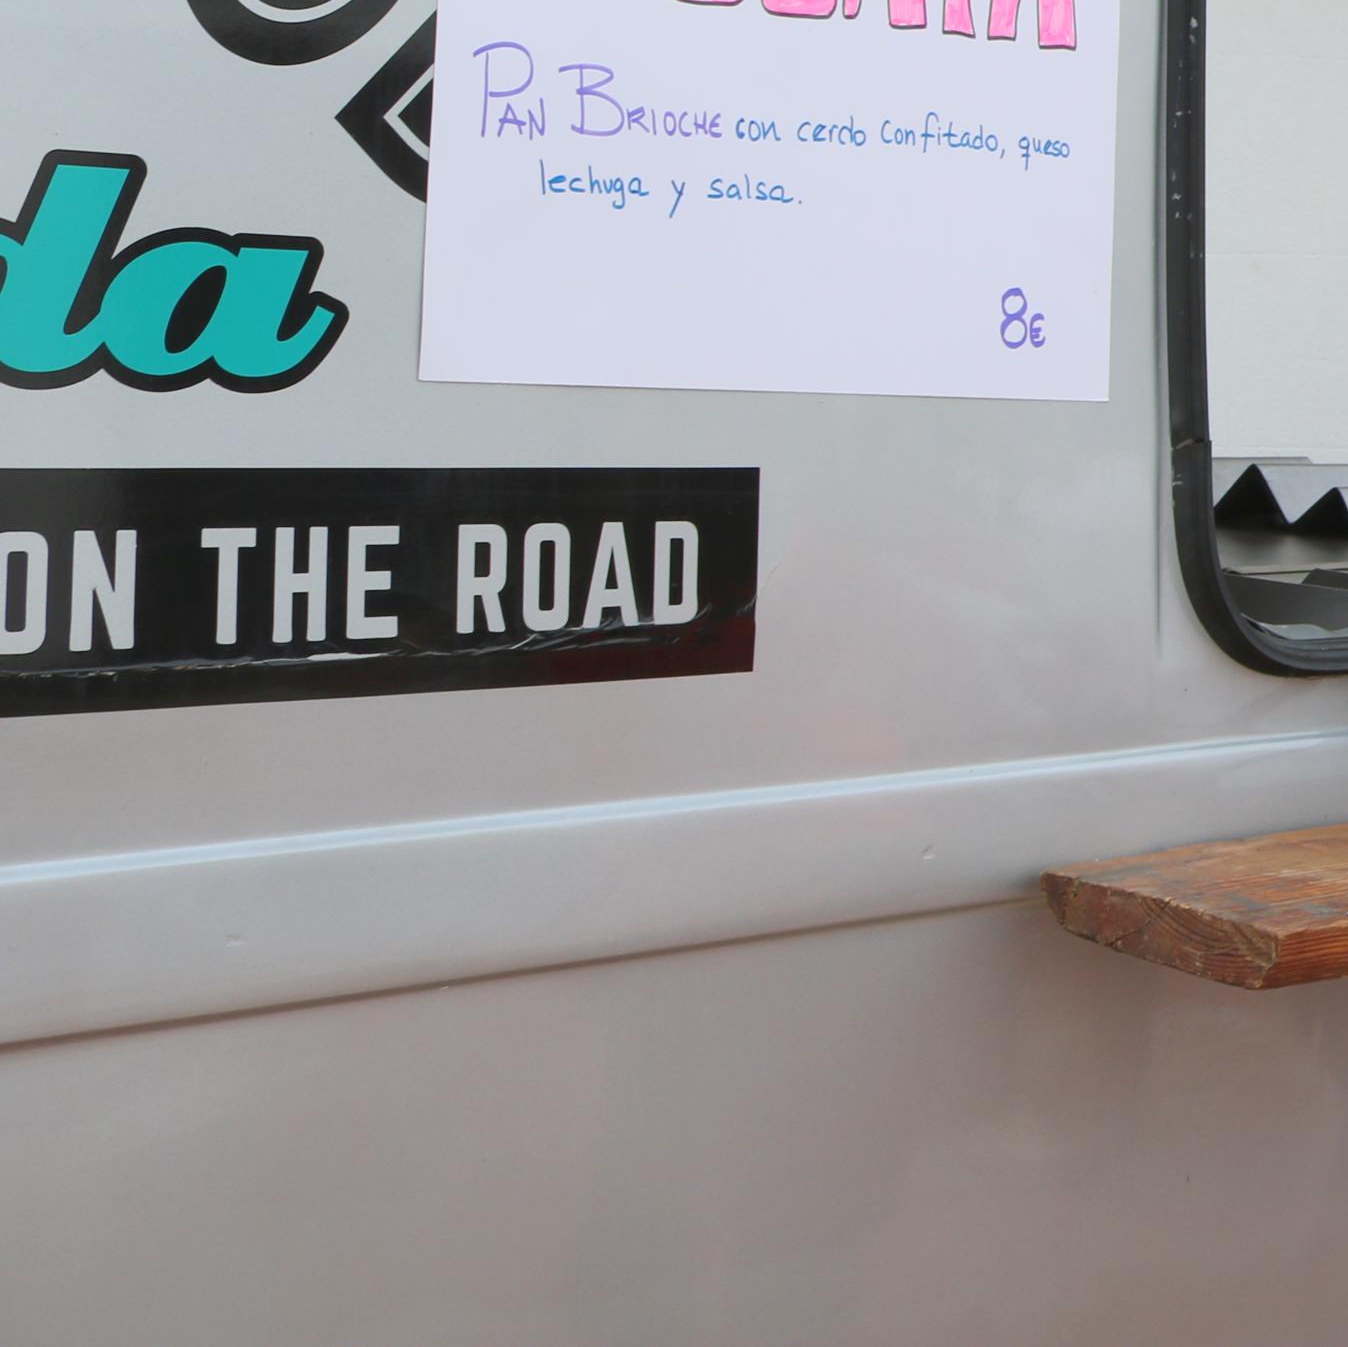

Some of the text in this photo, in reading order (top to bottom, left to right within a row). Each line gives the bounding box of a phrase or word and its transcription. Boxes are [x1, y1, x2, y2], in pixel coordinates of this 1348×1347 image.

[735, 117, 782, 142] con
[797, 116, 867, 147] cerdo
[1018, 135, 1071, 171] queso
[539, 159, 650, 209] lechuga
[669, 178, 686, 218] y
[1000, 287, 1046, 349] 8€
[200, 525, 400, 646] THE
[455, 519, 699, 635] ROAD
